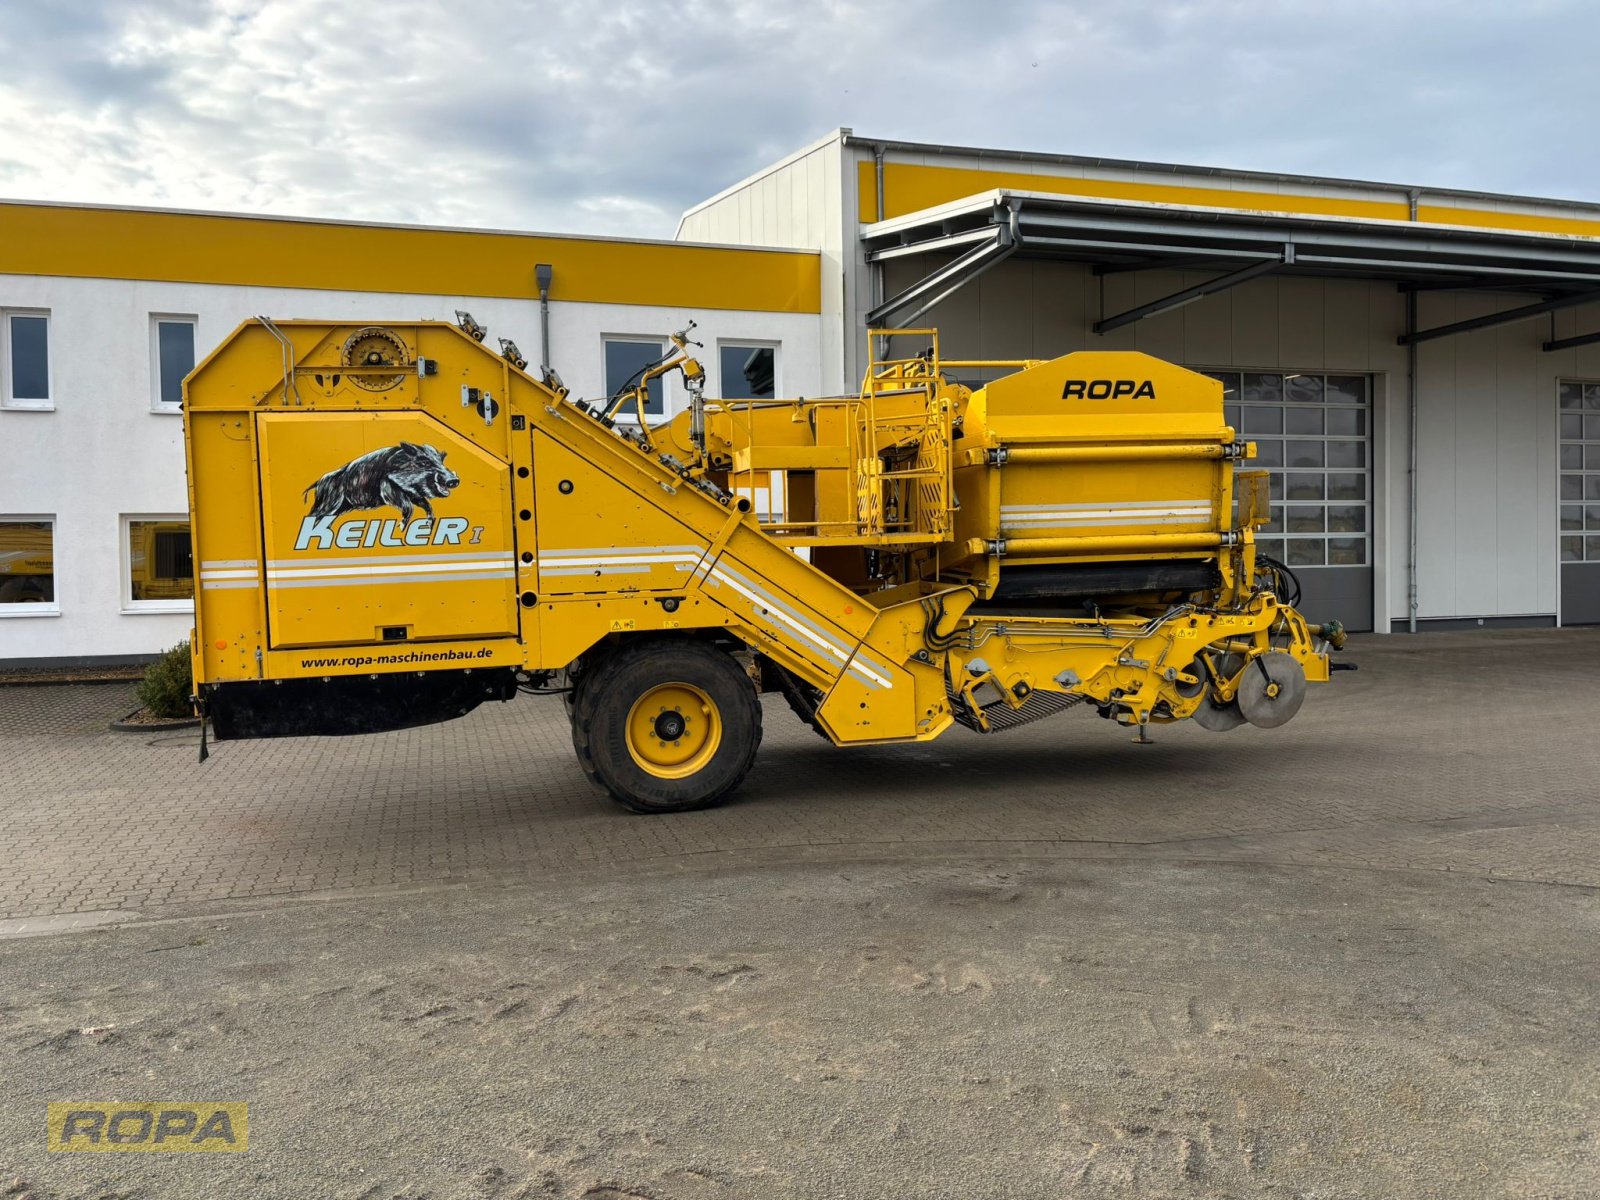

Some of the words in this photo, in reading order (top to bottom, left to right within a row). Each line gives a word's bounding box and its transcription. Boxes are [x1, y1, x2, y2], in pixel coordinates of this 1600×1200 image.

[1062, 380, 1155, 400] ROPA
[294, 515, 469, 550] KEILER
[469, 526, 484, 544] I
[302, 648, 493, 668] www.ropa-maschinenbau.de
